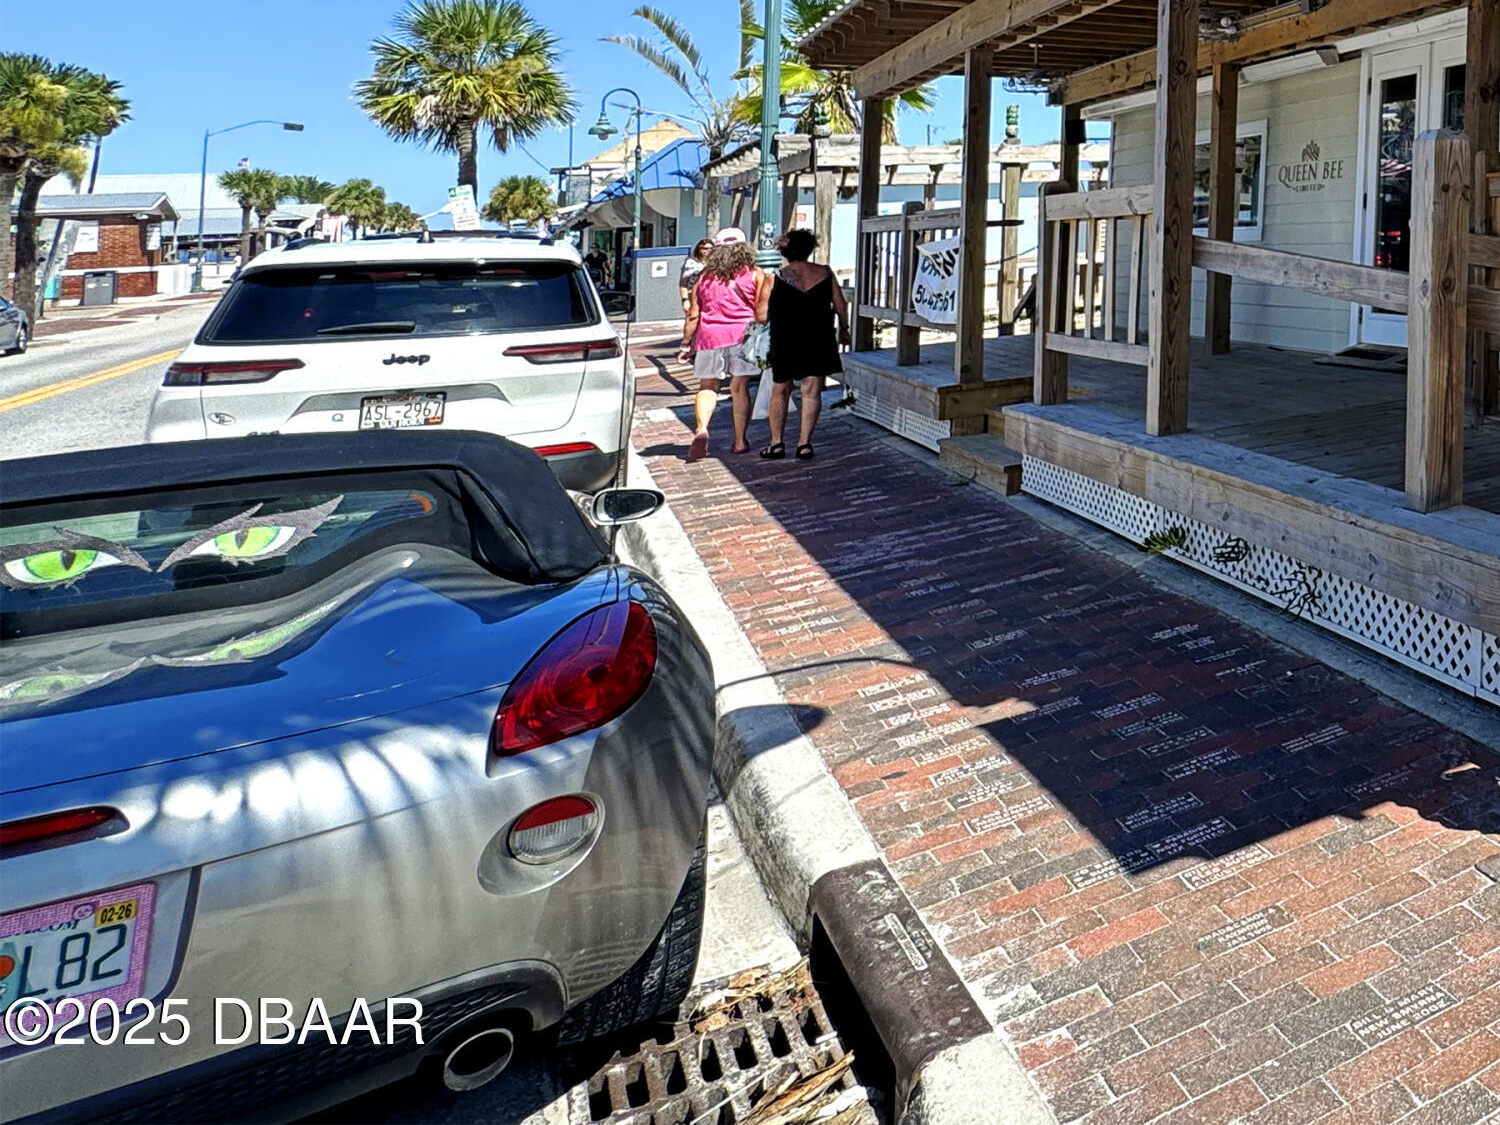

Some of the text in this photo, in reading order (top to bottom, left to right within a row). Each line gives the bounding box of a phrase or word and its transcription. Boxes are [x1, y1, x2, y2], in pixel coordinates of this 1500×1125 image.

[1278, 160, 1344, 188] QUEEN BEE
[382, 353, 430, 366] Jeep
[364, 401, 441, 421] ASL-2967
[101, 903, 132, 924] 02-26
[1397, 985, 1434, 1007] MARY
[1359, 991, 1445, 1036] NEW SMYRNA
[1377, 1019, 1411, 1039] JUNE
